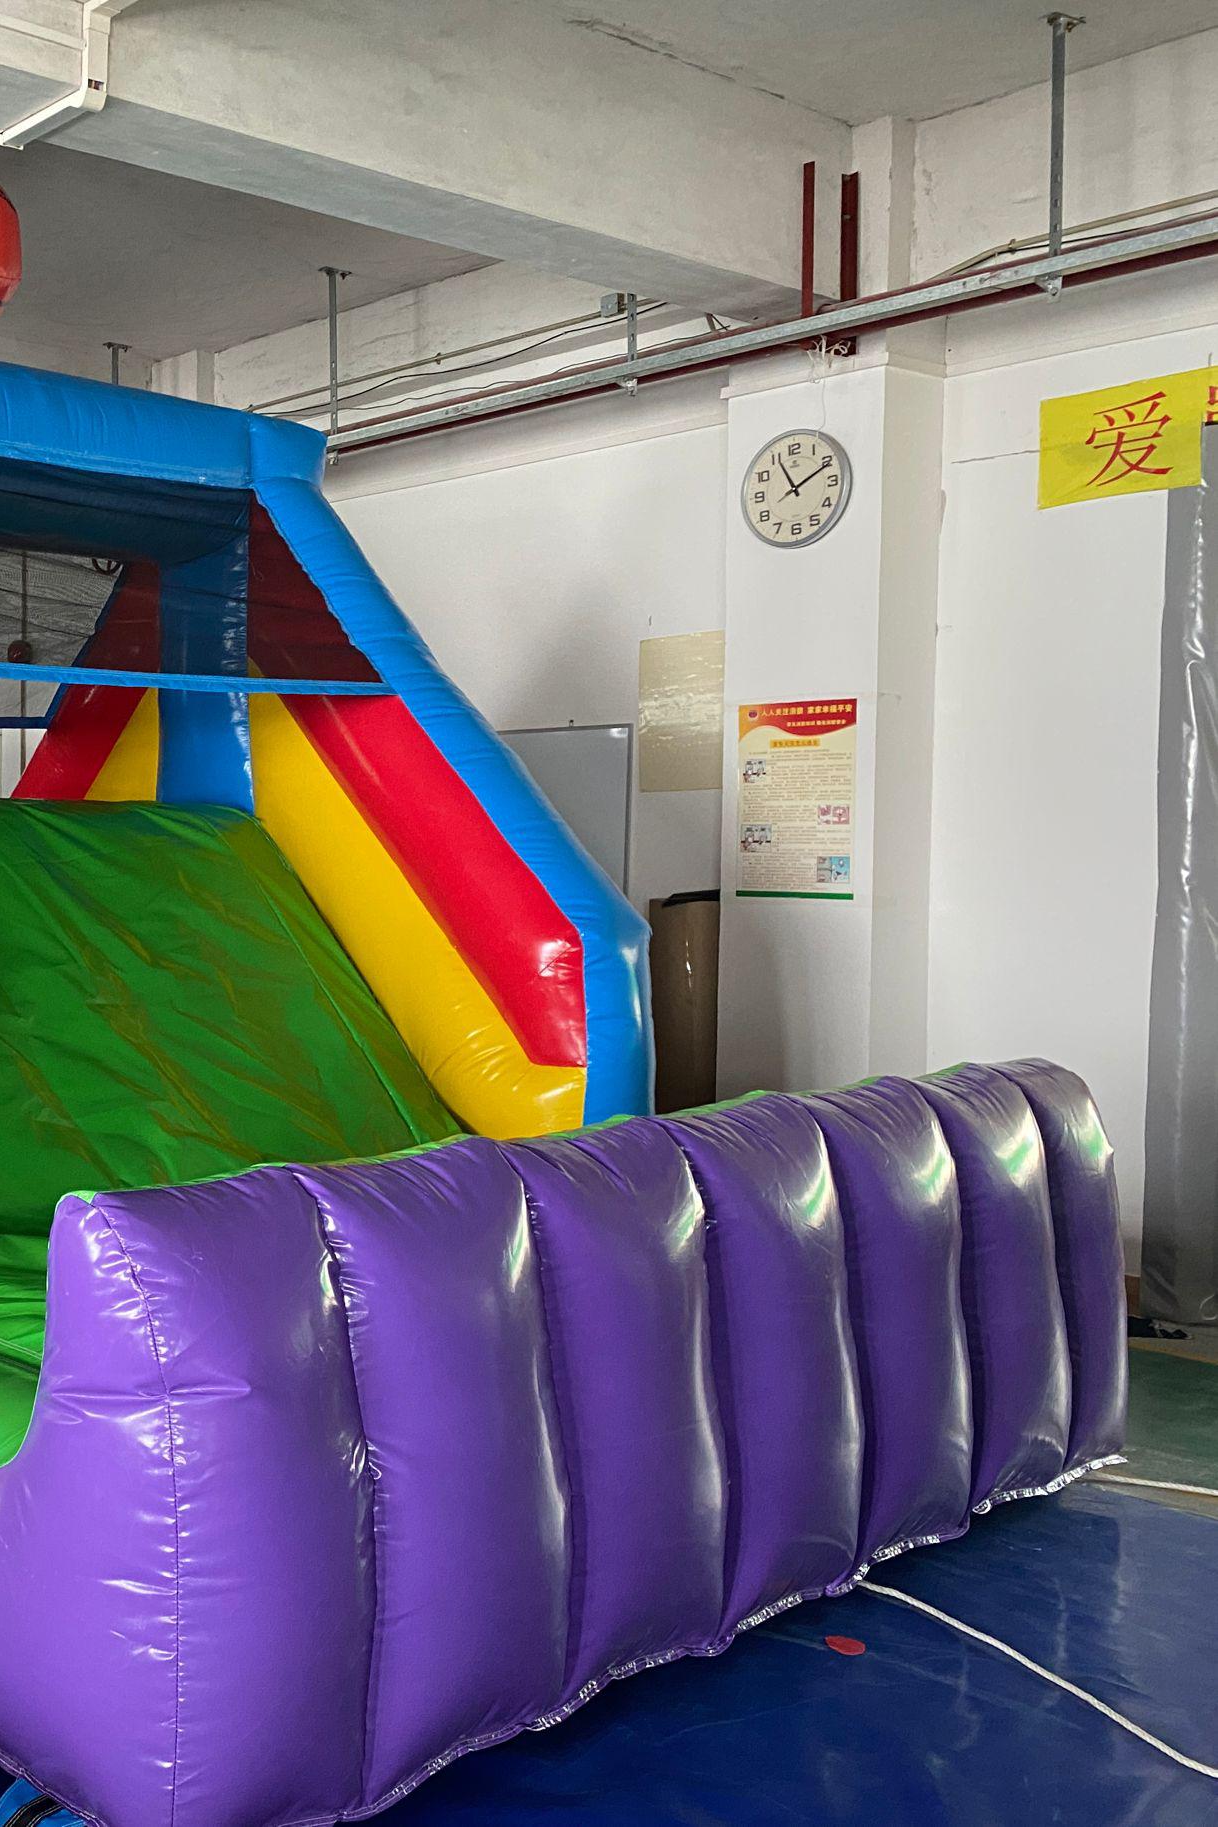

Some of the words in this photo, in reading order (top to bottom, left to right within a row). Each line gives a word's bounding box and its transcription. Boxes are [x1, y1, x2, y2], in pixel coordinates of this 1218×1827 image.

[1085, 391, 1174, 487] 爱
[788, 442, 801, 456] 12
[771, 453, 781, 465] 11
[822, 455, 833, 467] 2
[755, 470, 770, 483] 10
[827, 474, 838, 487] 3
[754, 491, 765, 503] 9
[822, 497, 833, 508] 4
[759, 510, 770, 522] 8
[809, 514, 820, 526] 5
[773, 522, 783, 534] 7
[791, 523, 802, 535] 6
